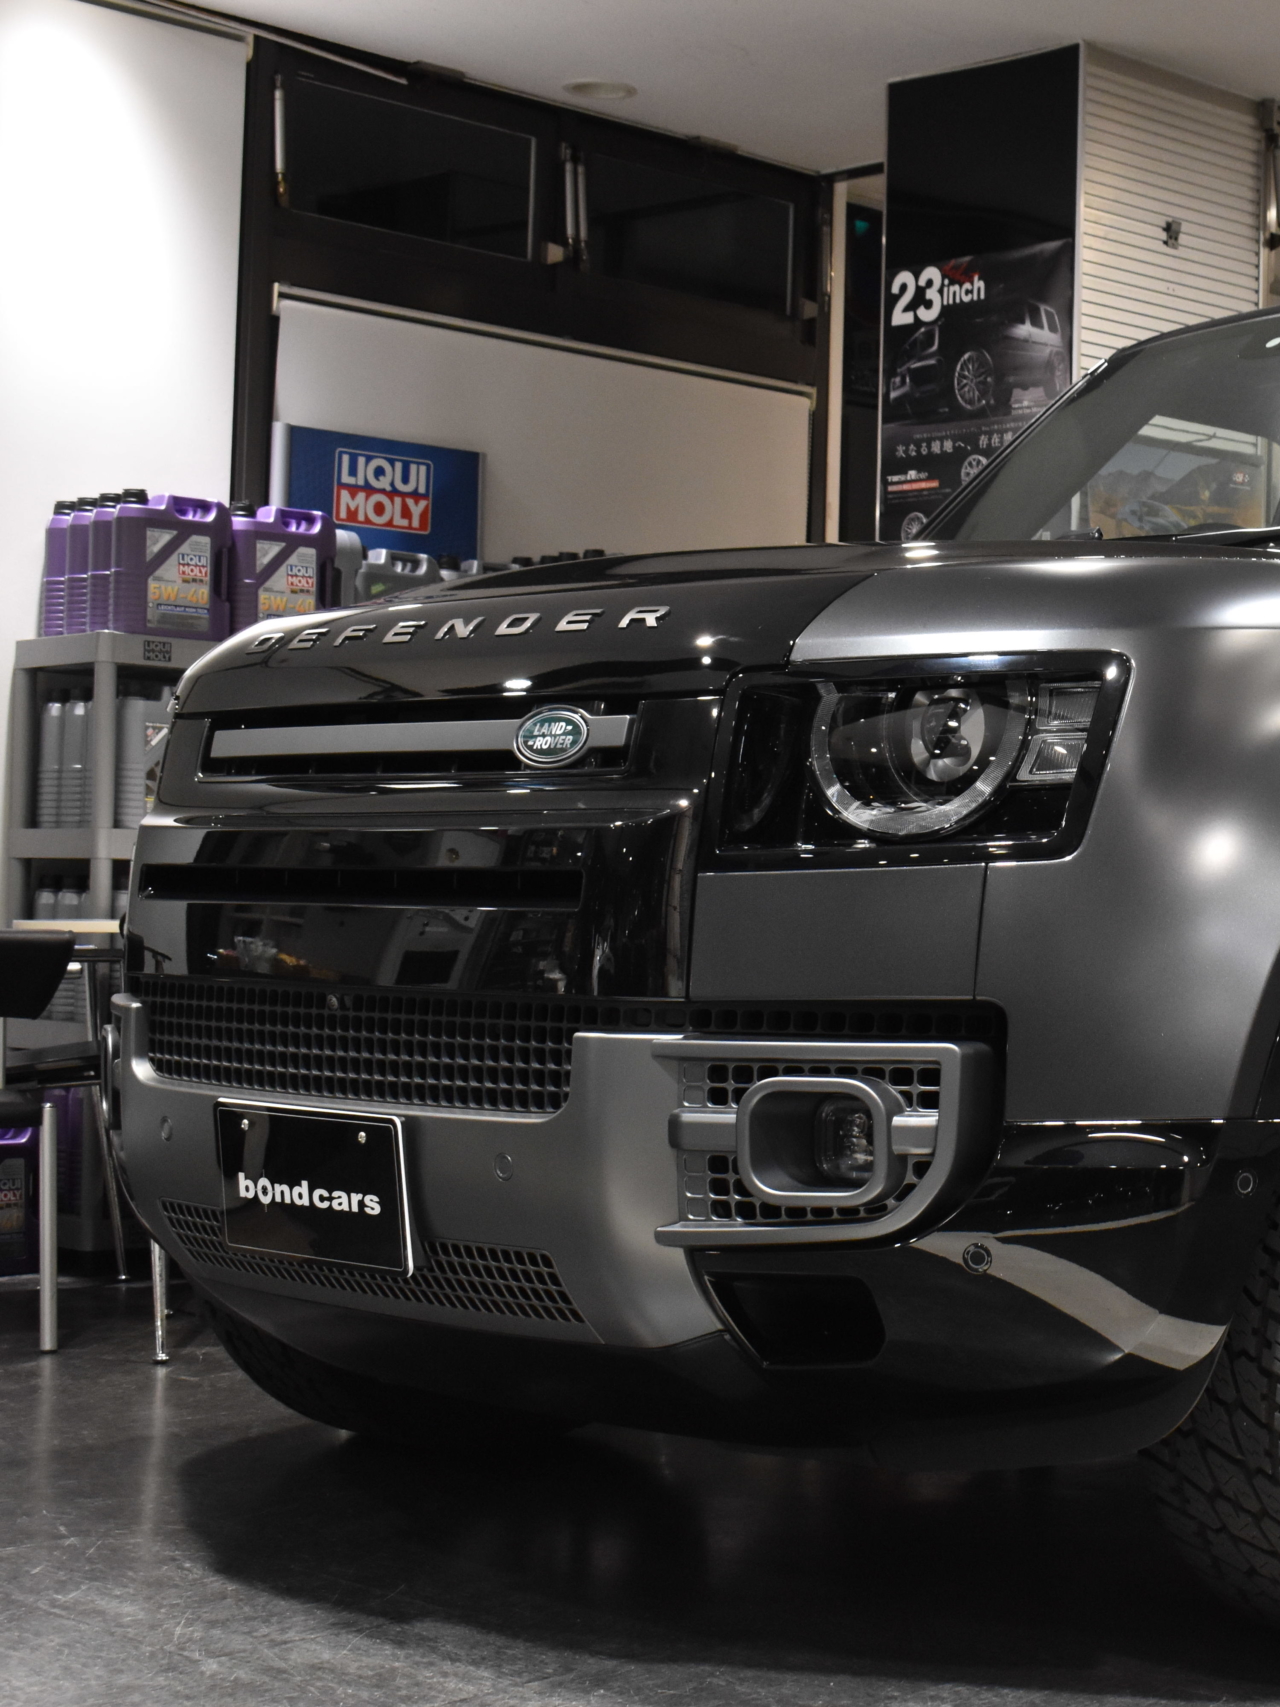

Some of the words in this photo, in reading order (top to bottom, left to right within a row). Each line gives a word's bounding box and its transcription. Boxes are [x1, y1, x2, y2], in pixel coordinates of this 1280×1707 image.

[340, 453, 428, 495] LIQUI
[339, 488, 430, 529] MOLY
[179, 553, 208, 566] LIQUI
[179, 565, 209, 578] MOLY
[288, 564, 314, 577] LIQUI
[287, 576, 315, 588] MOLY
[150, 583, 209, 605] 5W-40
[260, 594, 315, 613] 5W-40
[246, 604, 671, 656] DEFENDER
[145, 641, 171, 652] LIQUI
[145, 651, 171, 661] MOLY
[533, 720, 566, 736] LAND
[533, 734, 574, 750] ROVER
[0, 1178, 21, 1190] QUI
[0, 1189, 22, 1201] OLY
[237, 1170, 382, 1216] bondcars
